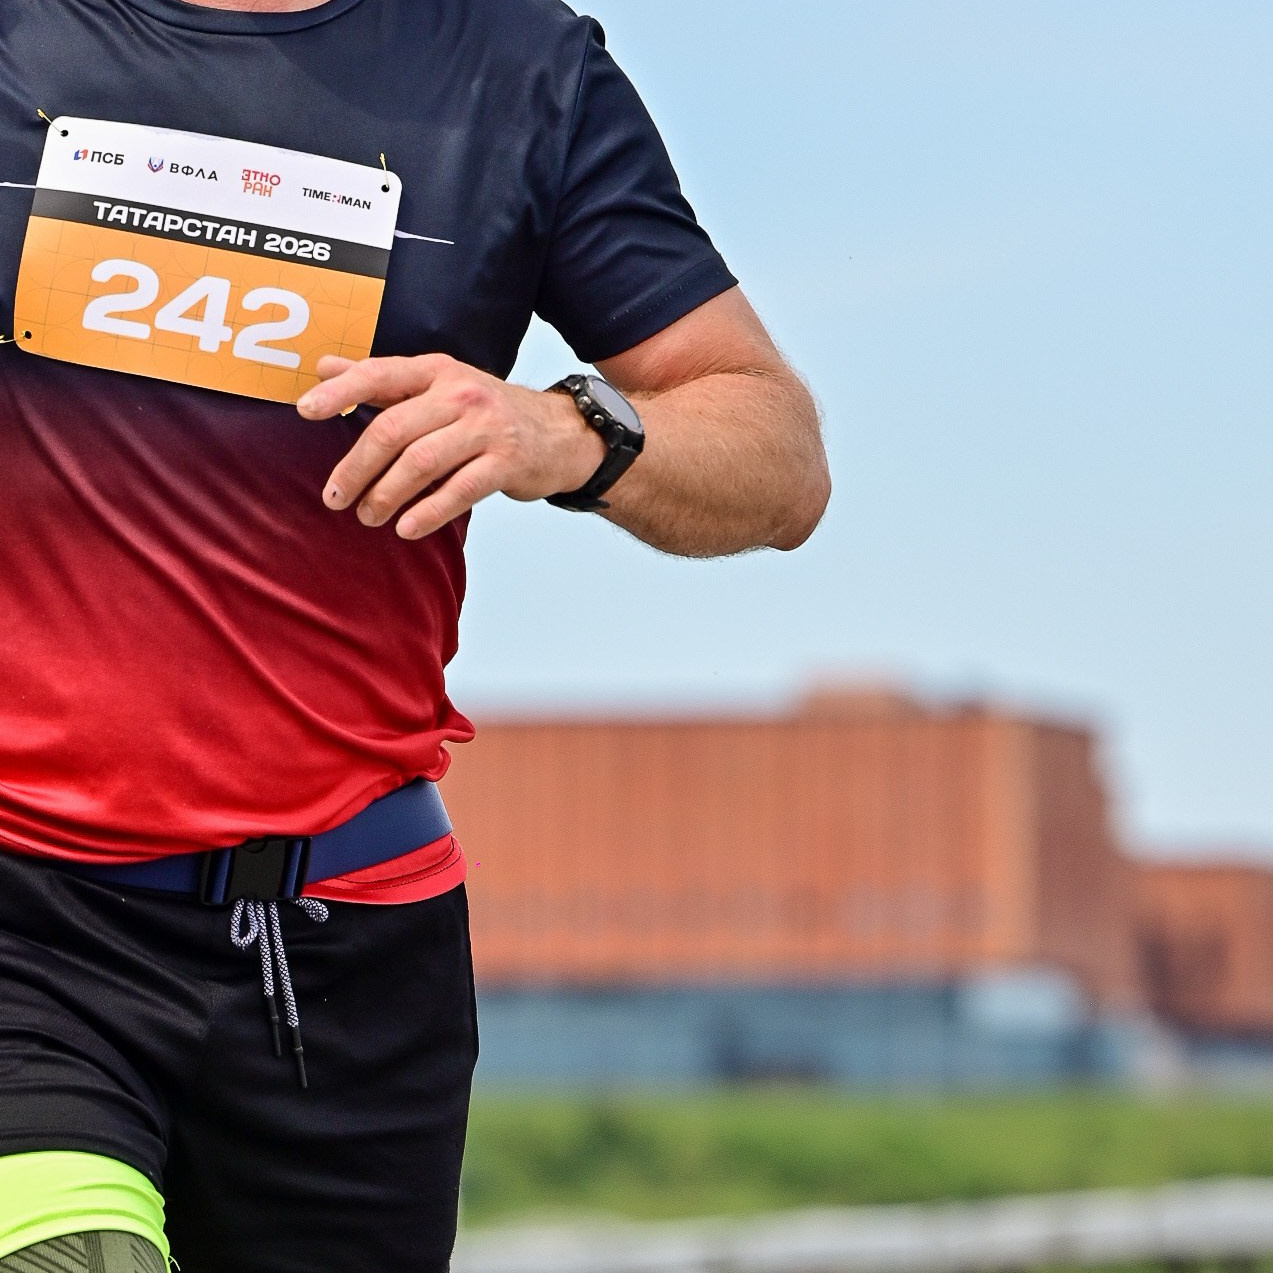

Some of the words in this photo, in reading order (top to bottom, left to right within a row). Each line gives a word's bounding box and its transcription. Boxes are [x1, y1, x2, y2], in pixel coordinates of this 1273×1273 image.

[91, 151, 124, 165] ПСБ
[169, 163, 218, 181] ВФЛА
[241, 169, 281, 186] ЭТНО
[243, 182, 273, 198] РАН
[93, 201, 256, 248] ТАТАРСТАН
[263, 233, 331, 261] 2026
[81, 258, 310, 369] 242
